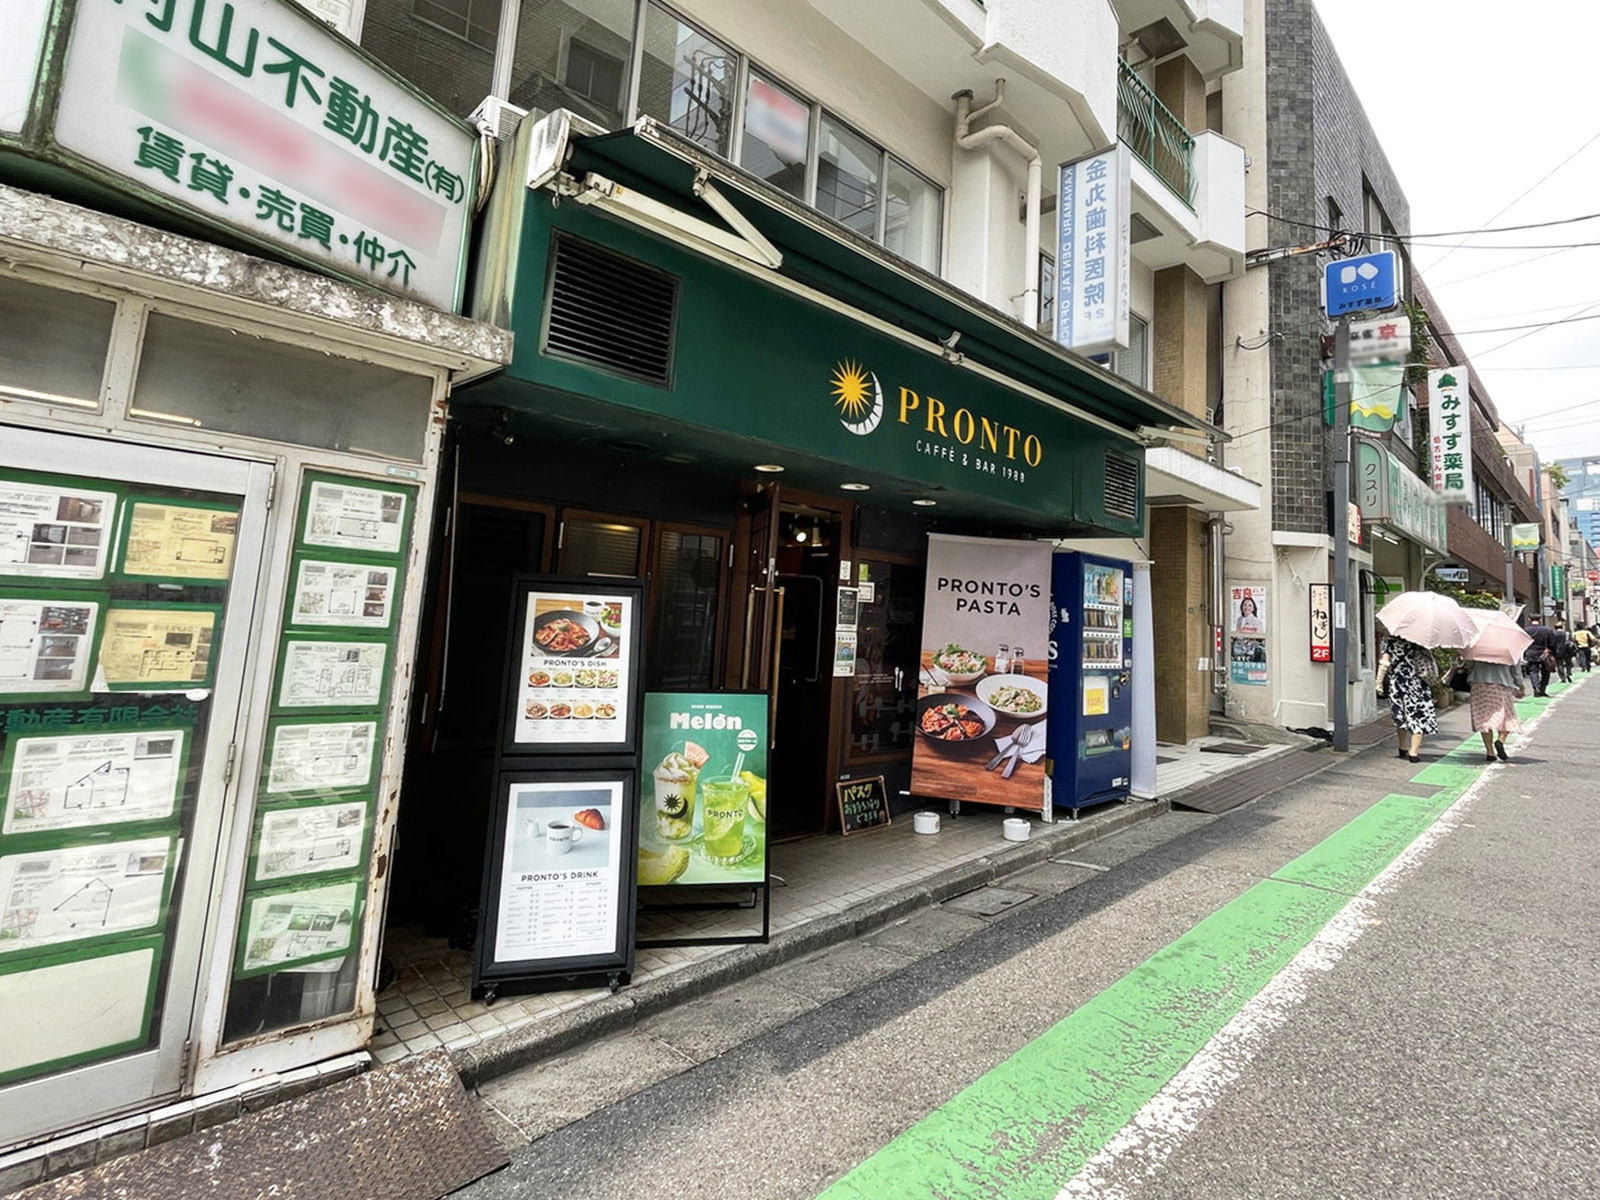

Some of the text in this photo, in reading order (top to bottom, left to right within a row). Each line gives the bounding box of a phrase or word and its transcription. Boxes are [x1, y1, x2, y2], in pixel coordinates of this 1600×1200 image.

[135, 125, 417, 285] 賃貸・売買・仲介
[897, 385, 1042, 468] PRONTO
[1441, 394, 1464, 490] みすず薬局
[962, 453, 968, 466] &
[976, 458, 996, 475] BAR
[1365, 463, 1378, 507] クスリ
[937, 577, 1041, 598] PRONTO'S
[956, 598, 1021, 616] PASTA
[543, 659, 585, 667] PRONTO'S
[1313, 649, 1329, 658] 2F
[844, 783, 873, 802] パスタ
[521, 870, 599, 882] PRONTO'S DRINK
